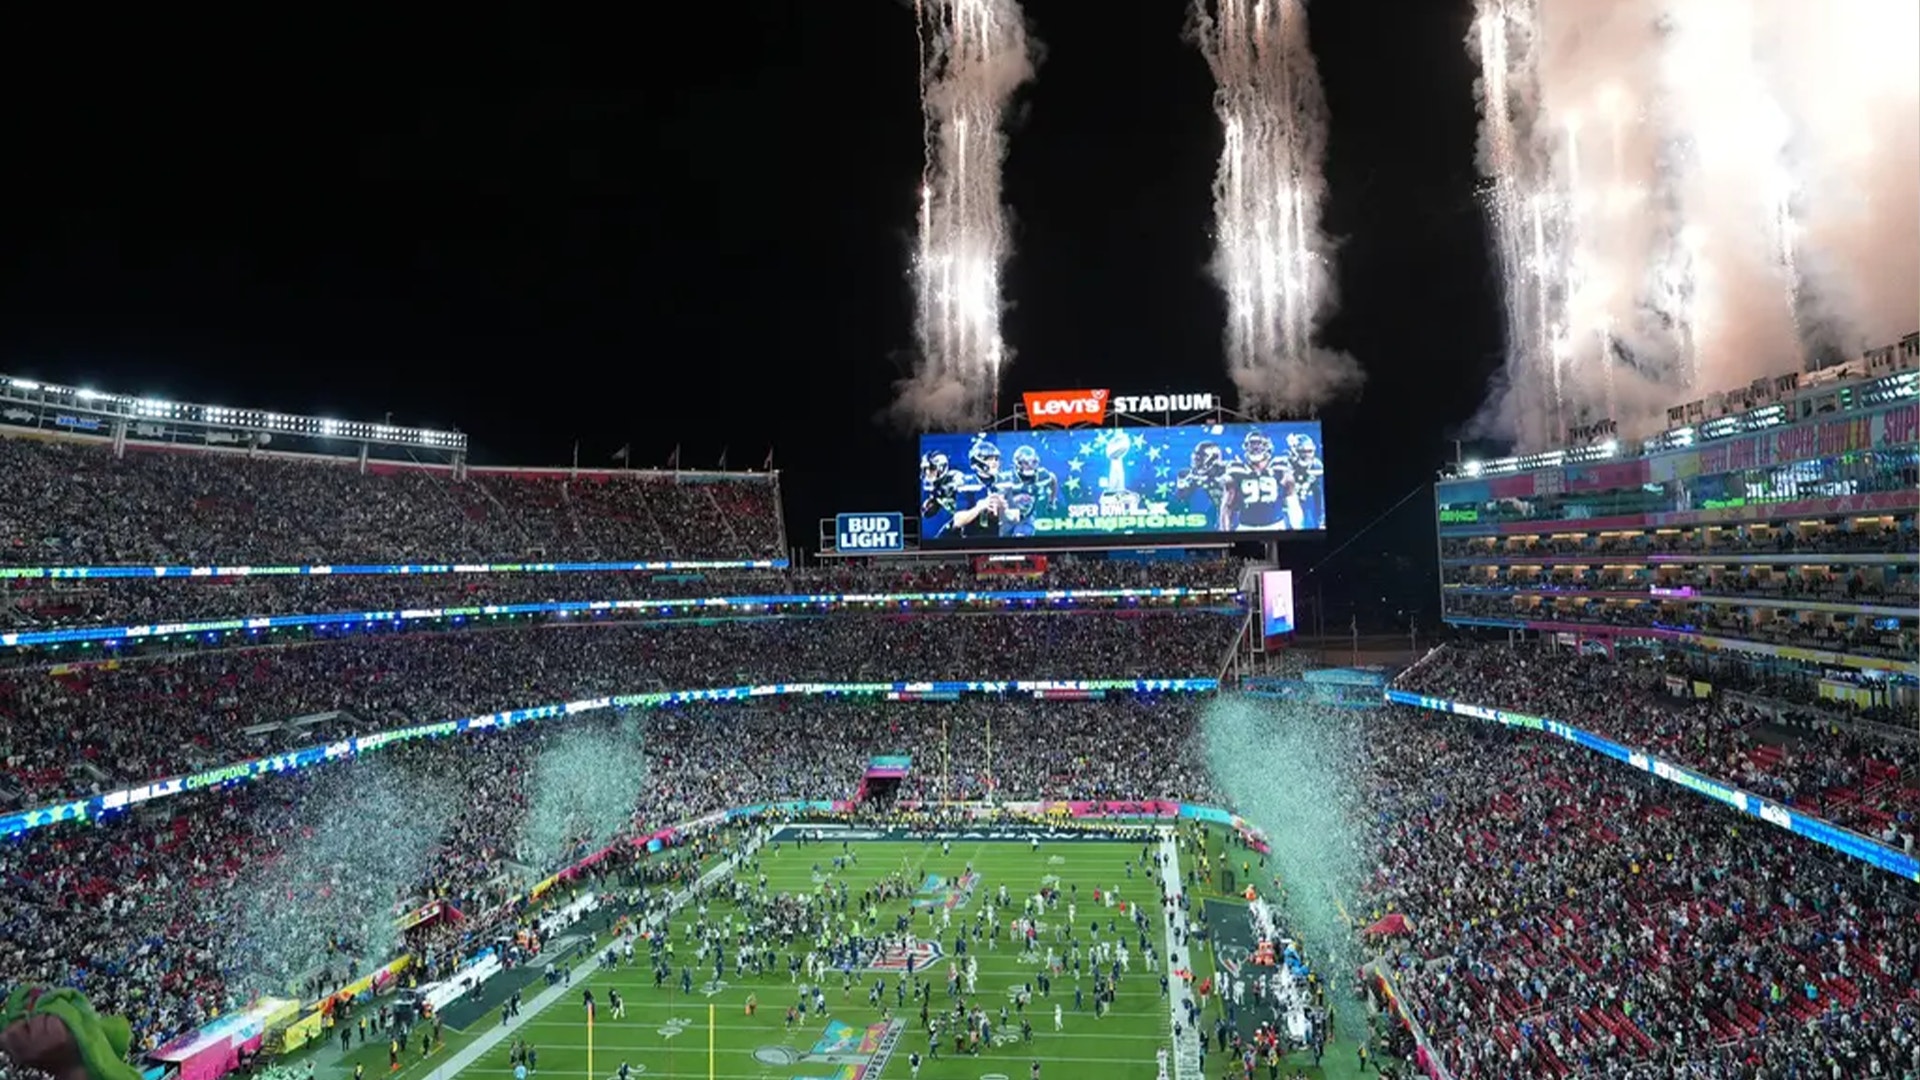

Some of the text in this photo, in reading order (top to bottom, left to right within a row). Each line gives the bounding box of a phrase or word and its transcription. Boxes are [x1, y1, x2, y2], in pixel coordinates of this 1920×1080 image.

[1113, 393, 1212, 413] STADIUM
[1241, 477, 1278, 503] 99
[1068, 504, 1099, 518] SUPER
[848, 516, 892, 532] BUD
[1033, 513, 1208, 531] CHAMPIONS
[840, 532, 899, 548] LIGHT
[186, 763, 250, 788] CHAMPIONS
